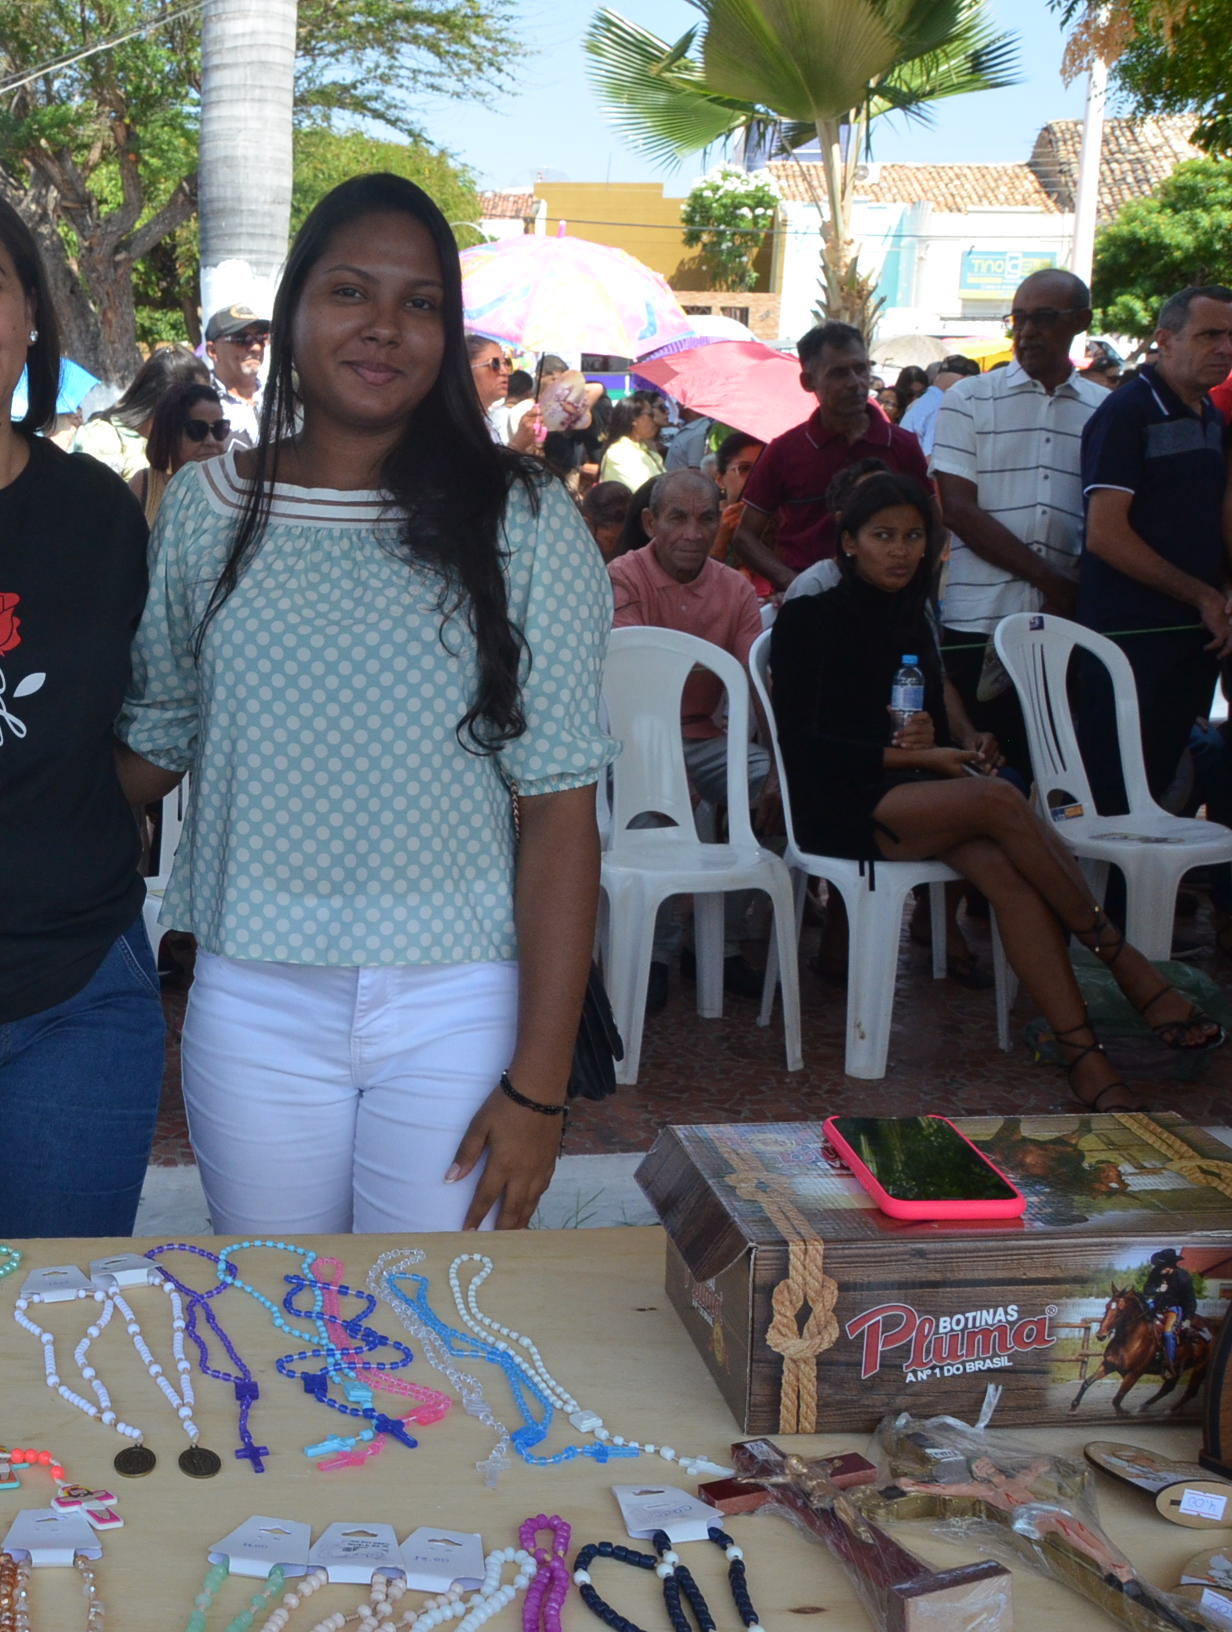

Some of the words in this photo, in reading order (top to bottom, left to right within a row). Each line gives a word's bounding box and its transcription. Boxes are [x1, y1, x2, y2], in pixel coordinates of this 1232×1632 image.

[938, 1304, 1020, 1334] BOTINAS
[845, 1303, 1057, 1380] Pluma
[905, 1371, 917, 1384] A
[943, 1364, 963, 1377] DO
[964, 1356, 1013, 1375] BRASIL
